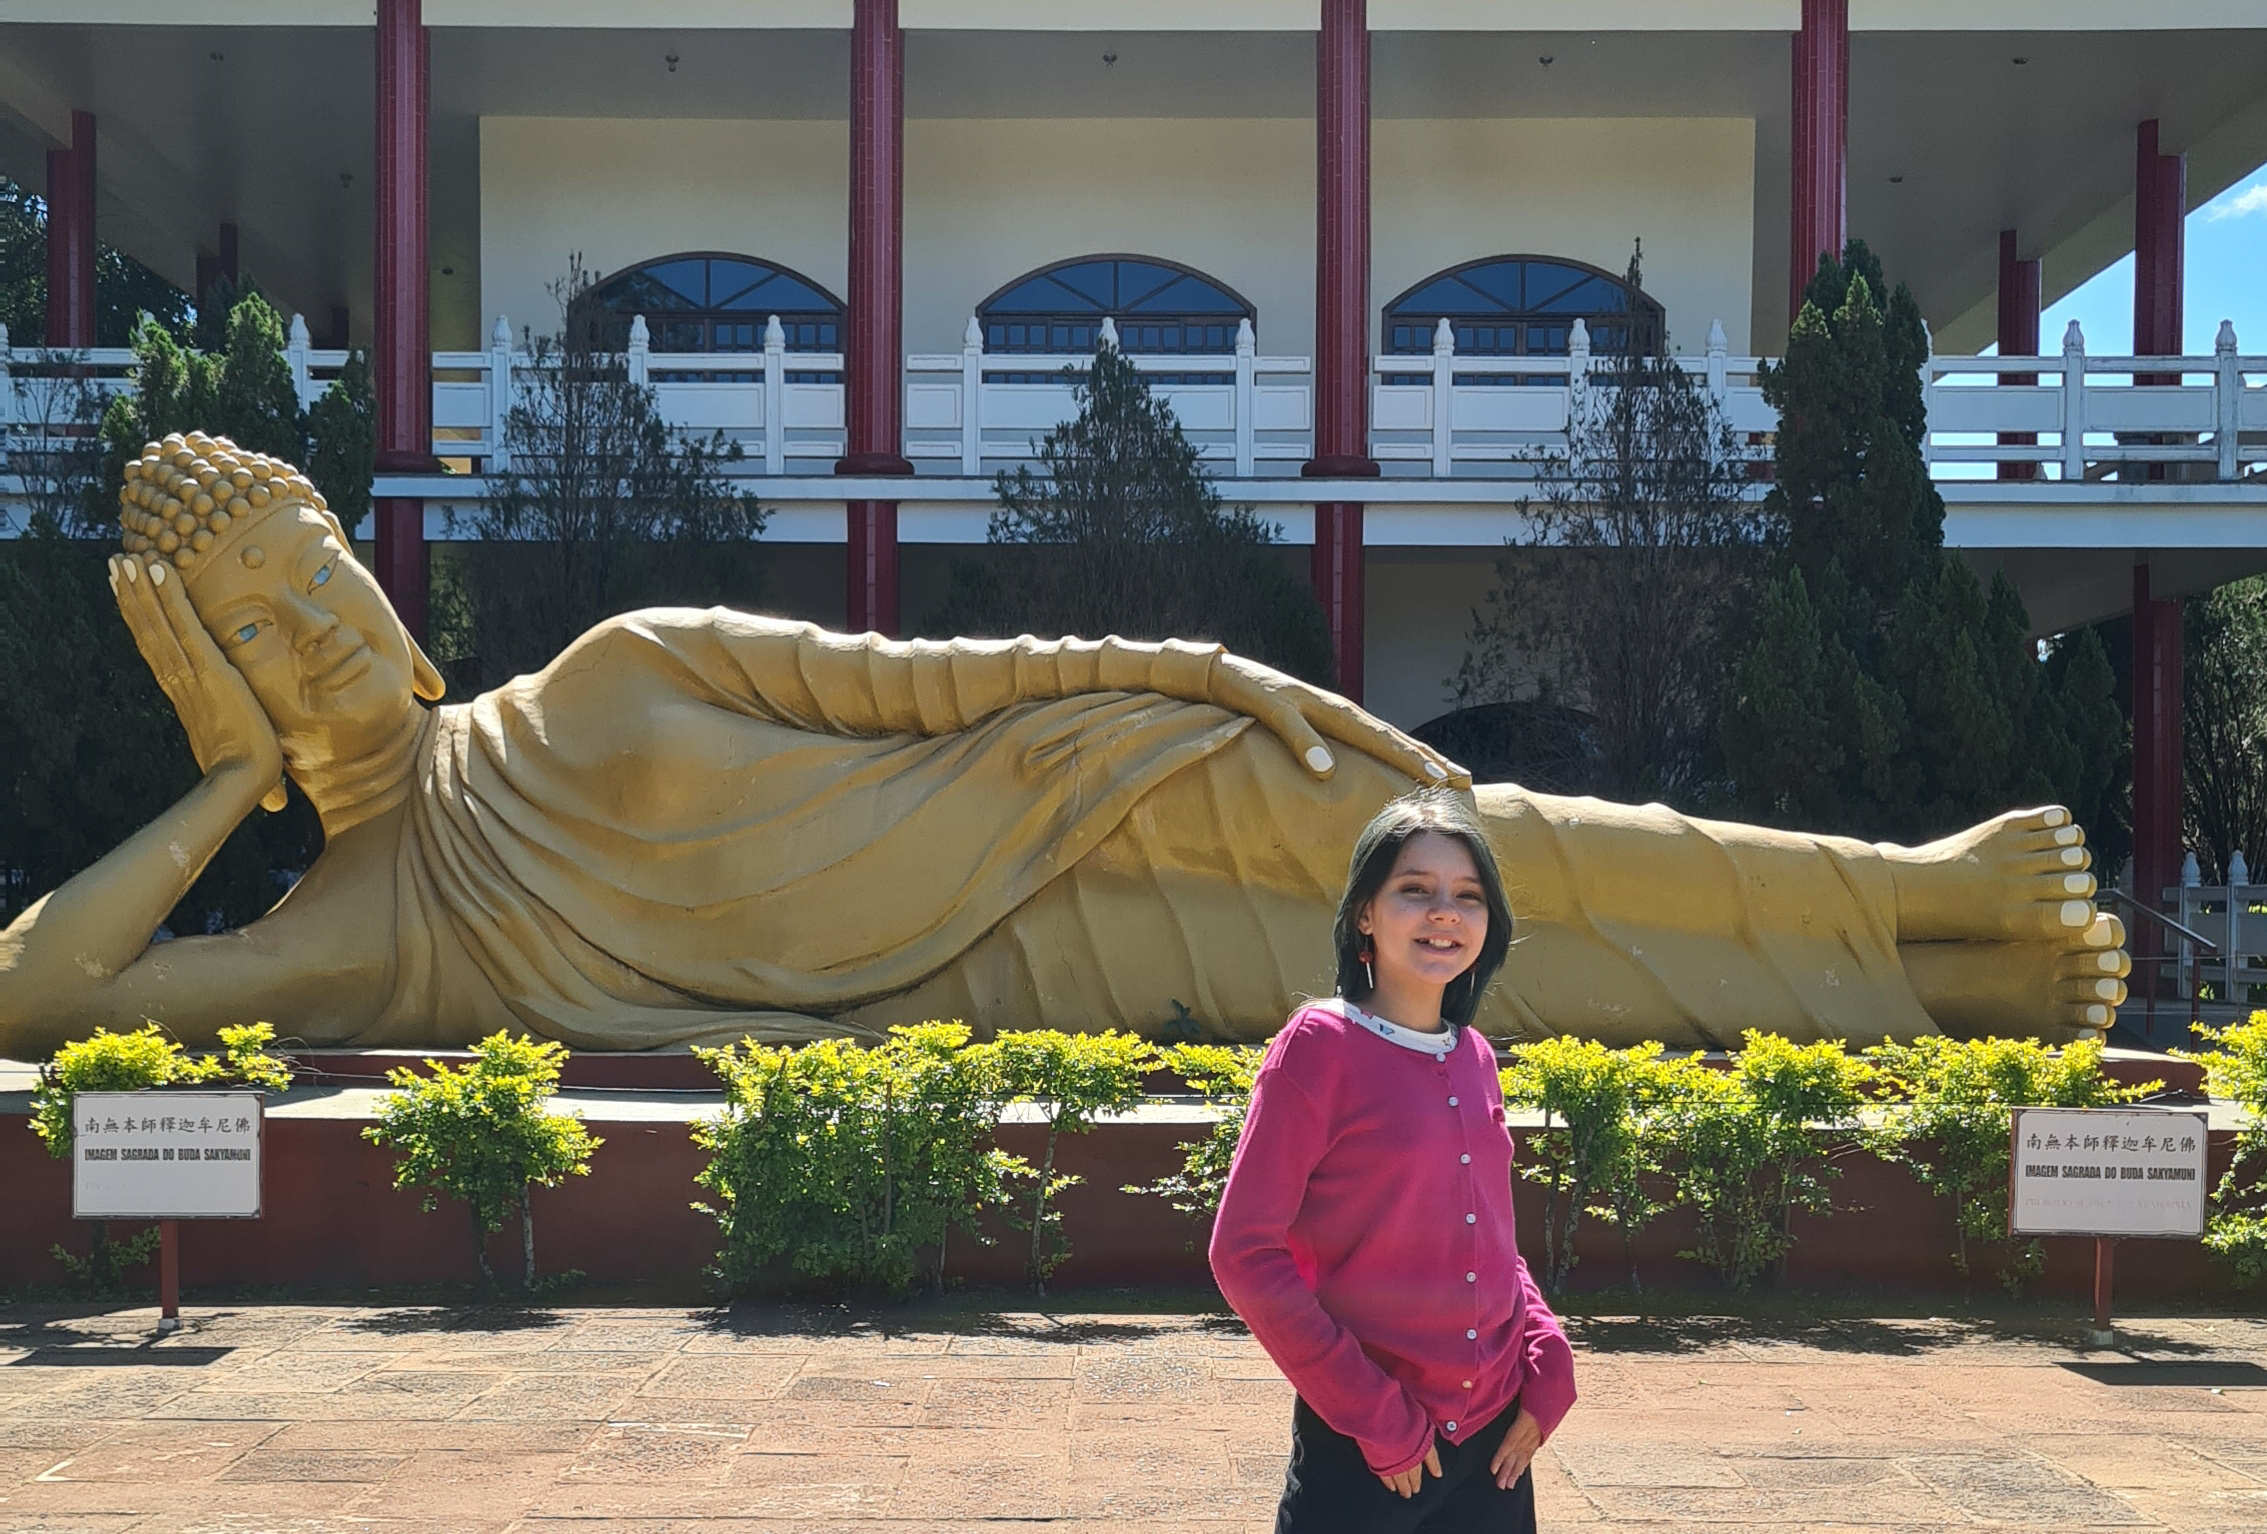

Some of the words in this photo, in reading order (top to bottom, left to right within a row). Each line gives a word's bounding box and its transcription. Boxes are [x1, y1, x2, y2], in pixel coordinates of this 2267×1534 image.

[84, 1116, 251, 1134] 南無本師釋迦牟尼佛
[2026, 1132, 2196, 1153] 南無本師釋迦牟尼佛
[85, 1148, 117, 1161] IMAGEM
[121, 1148, 159, 1161] SAGRADA
[163, 1148, 174, 1161] DO
[178, 1148, 201, 1161] BUDA
[204, 1148, 251, 1161] SAKYAMUNI
[2025, 1164, 2059, 1178] IMAGEM
[2062, 1165, 2101, 1179] SAGRADA
[2104, 1166, 2117, 1180] DO
[2120, 1166, 2144, 1180] BUDA
[2147, 1167, 2196, 1181] SAKYAMUNI
